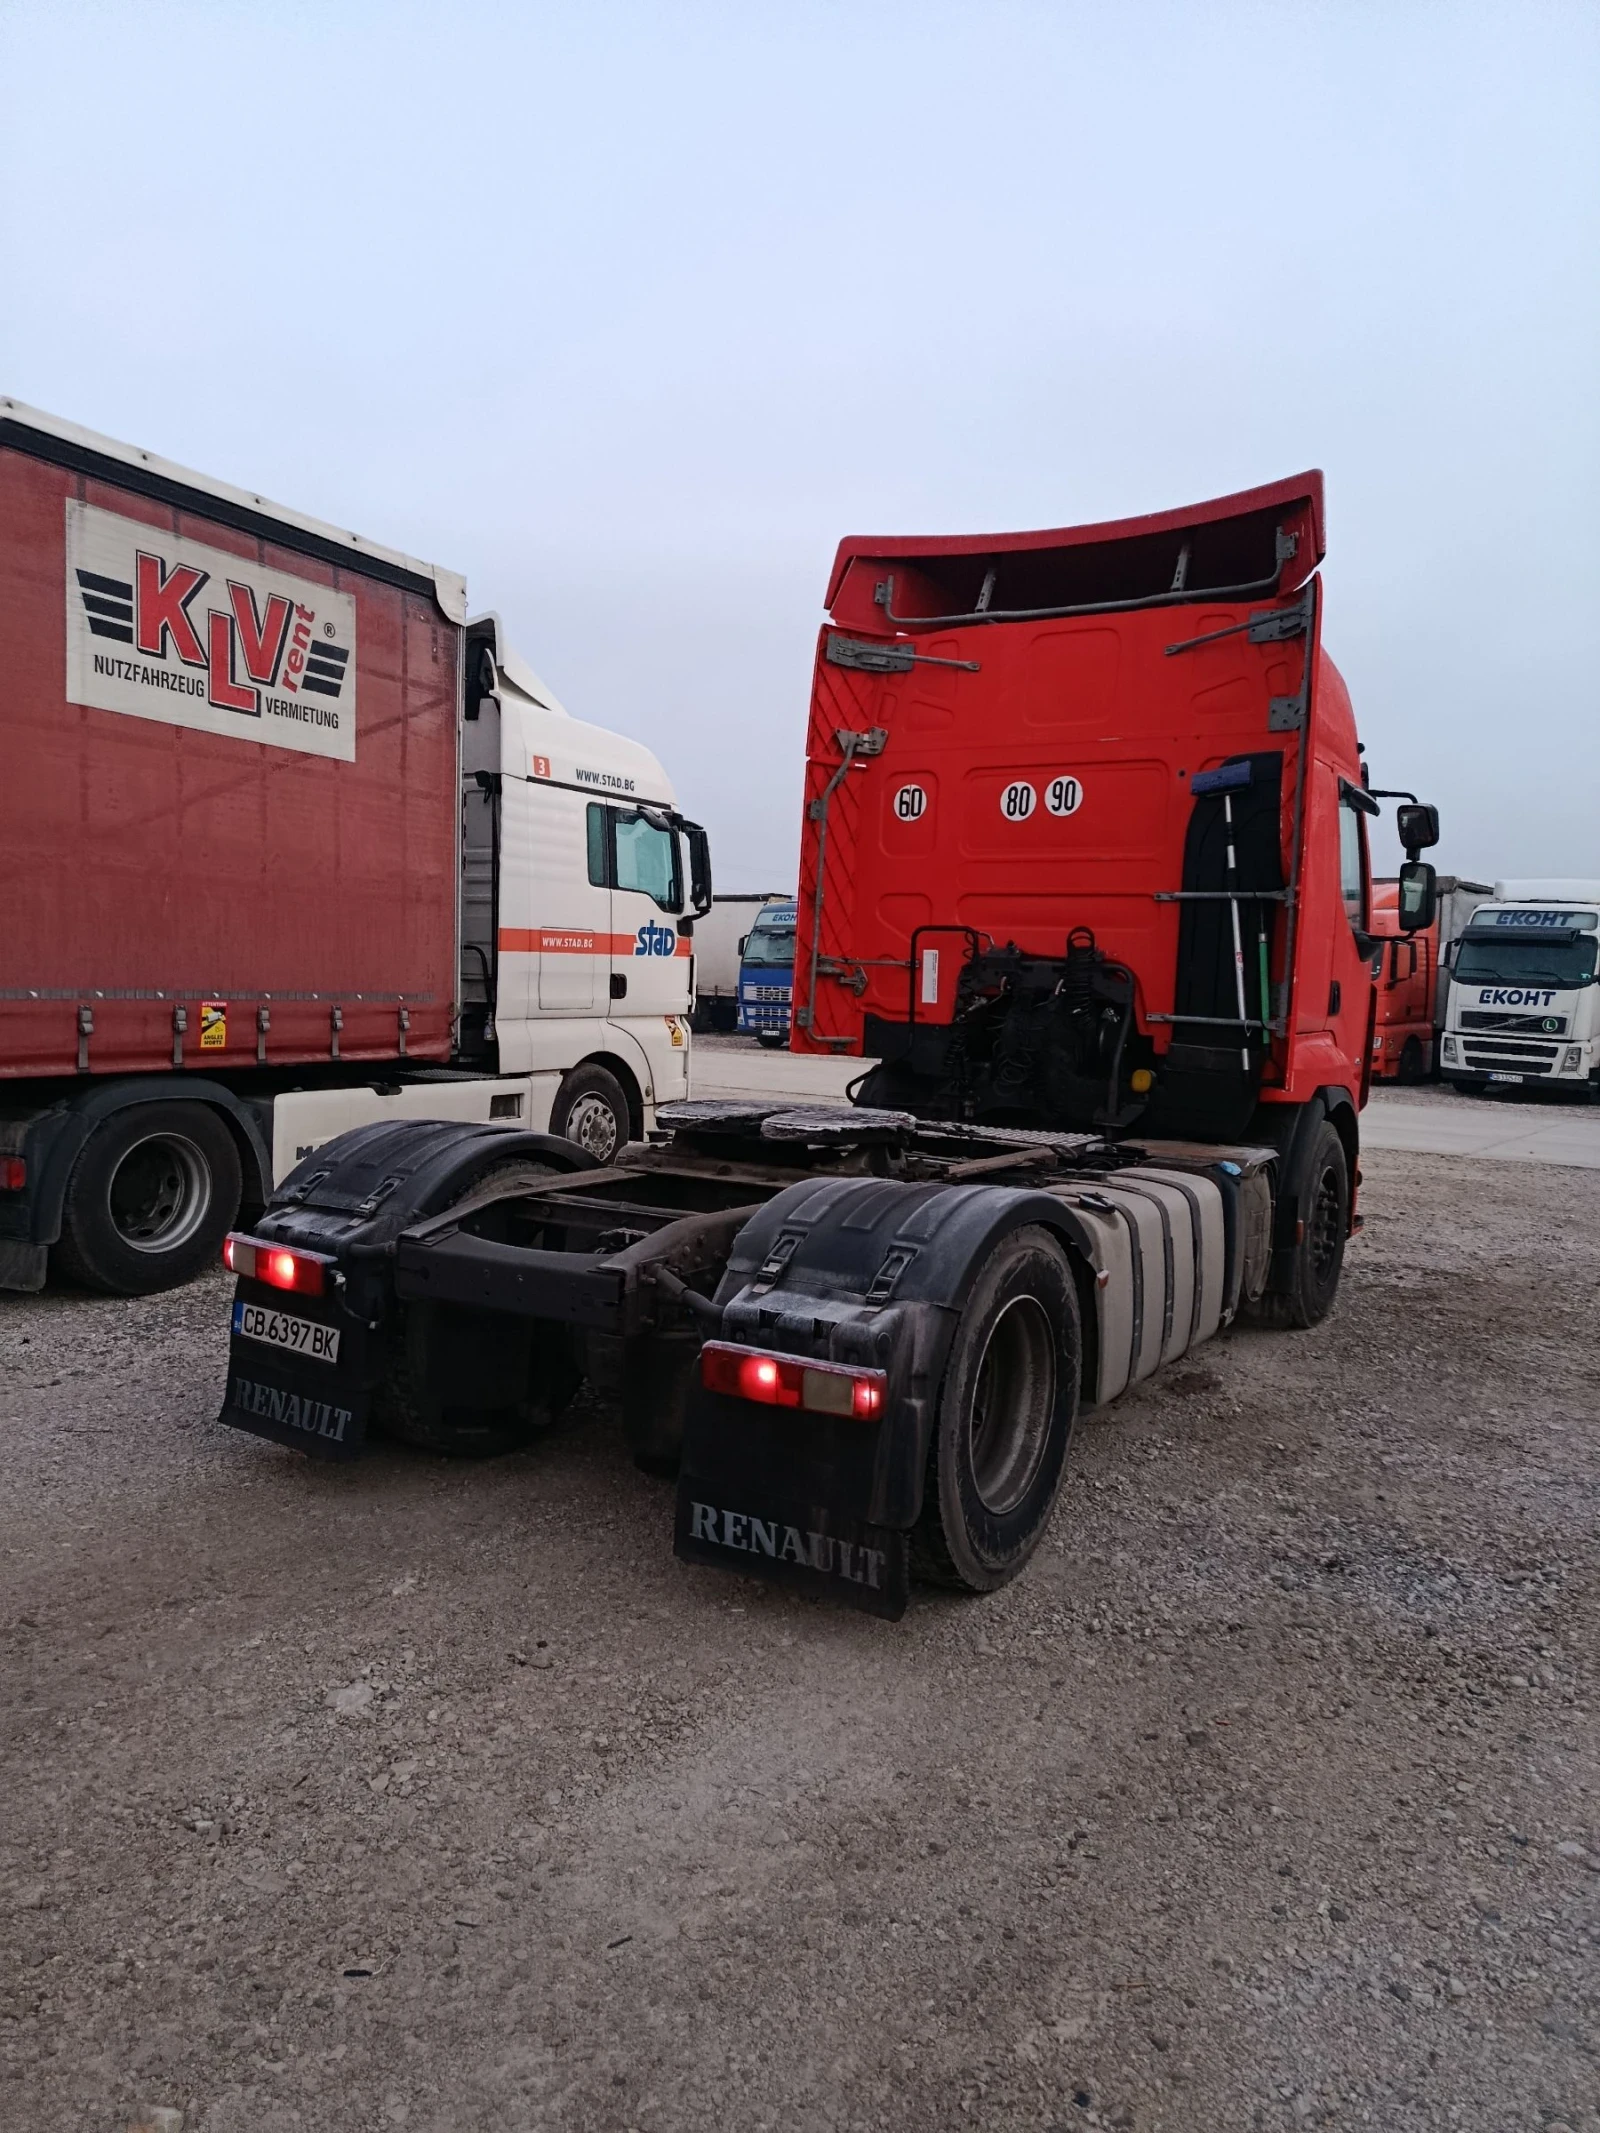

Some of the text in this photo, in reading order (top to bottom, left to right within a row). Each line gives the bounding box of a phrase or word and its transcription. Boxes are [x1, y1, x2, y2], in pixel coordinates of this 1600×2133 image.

[135, 548, 294, 718] KLV
[282, 603, 316, 693] rent
[94, 655, 205, 698] NUTZFAHRZEUG
[265, 696, 340, 730] VERMIETUNG
[538, 758, 546, 775] 3
[576, 768, 635, 791] WWW.STAD.BG
[900, 787, 923, 818] 60
[1006, 785, 1031, 817] 80
[1051, 780, 1077, 812] 90
[542, 937, 593, 948] WWW.STAD.BG
[1546, 1020, 1553, 1030] L
[233, 1376, 352, 1442] RENAULT
[689, 1500, 886, 1590] RENAULT
